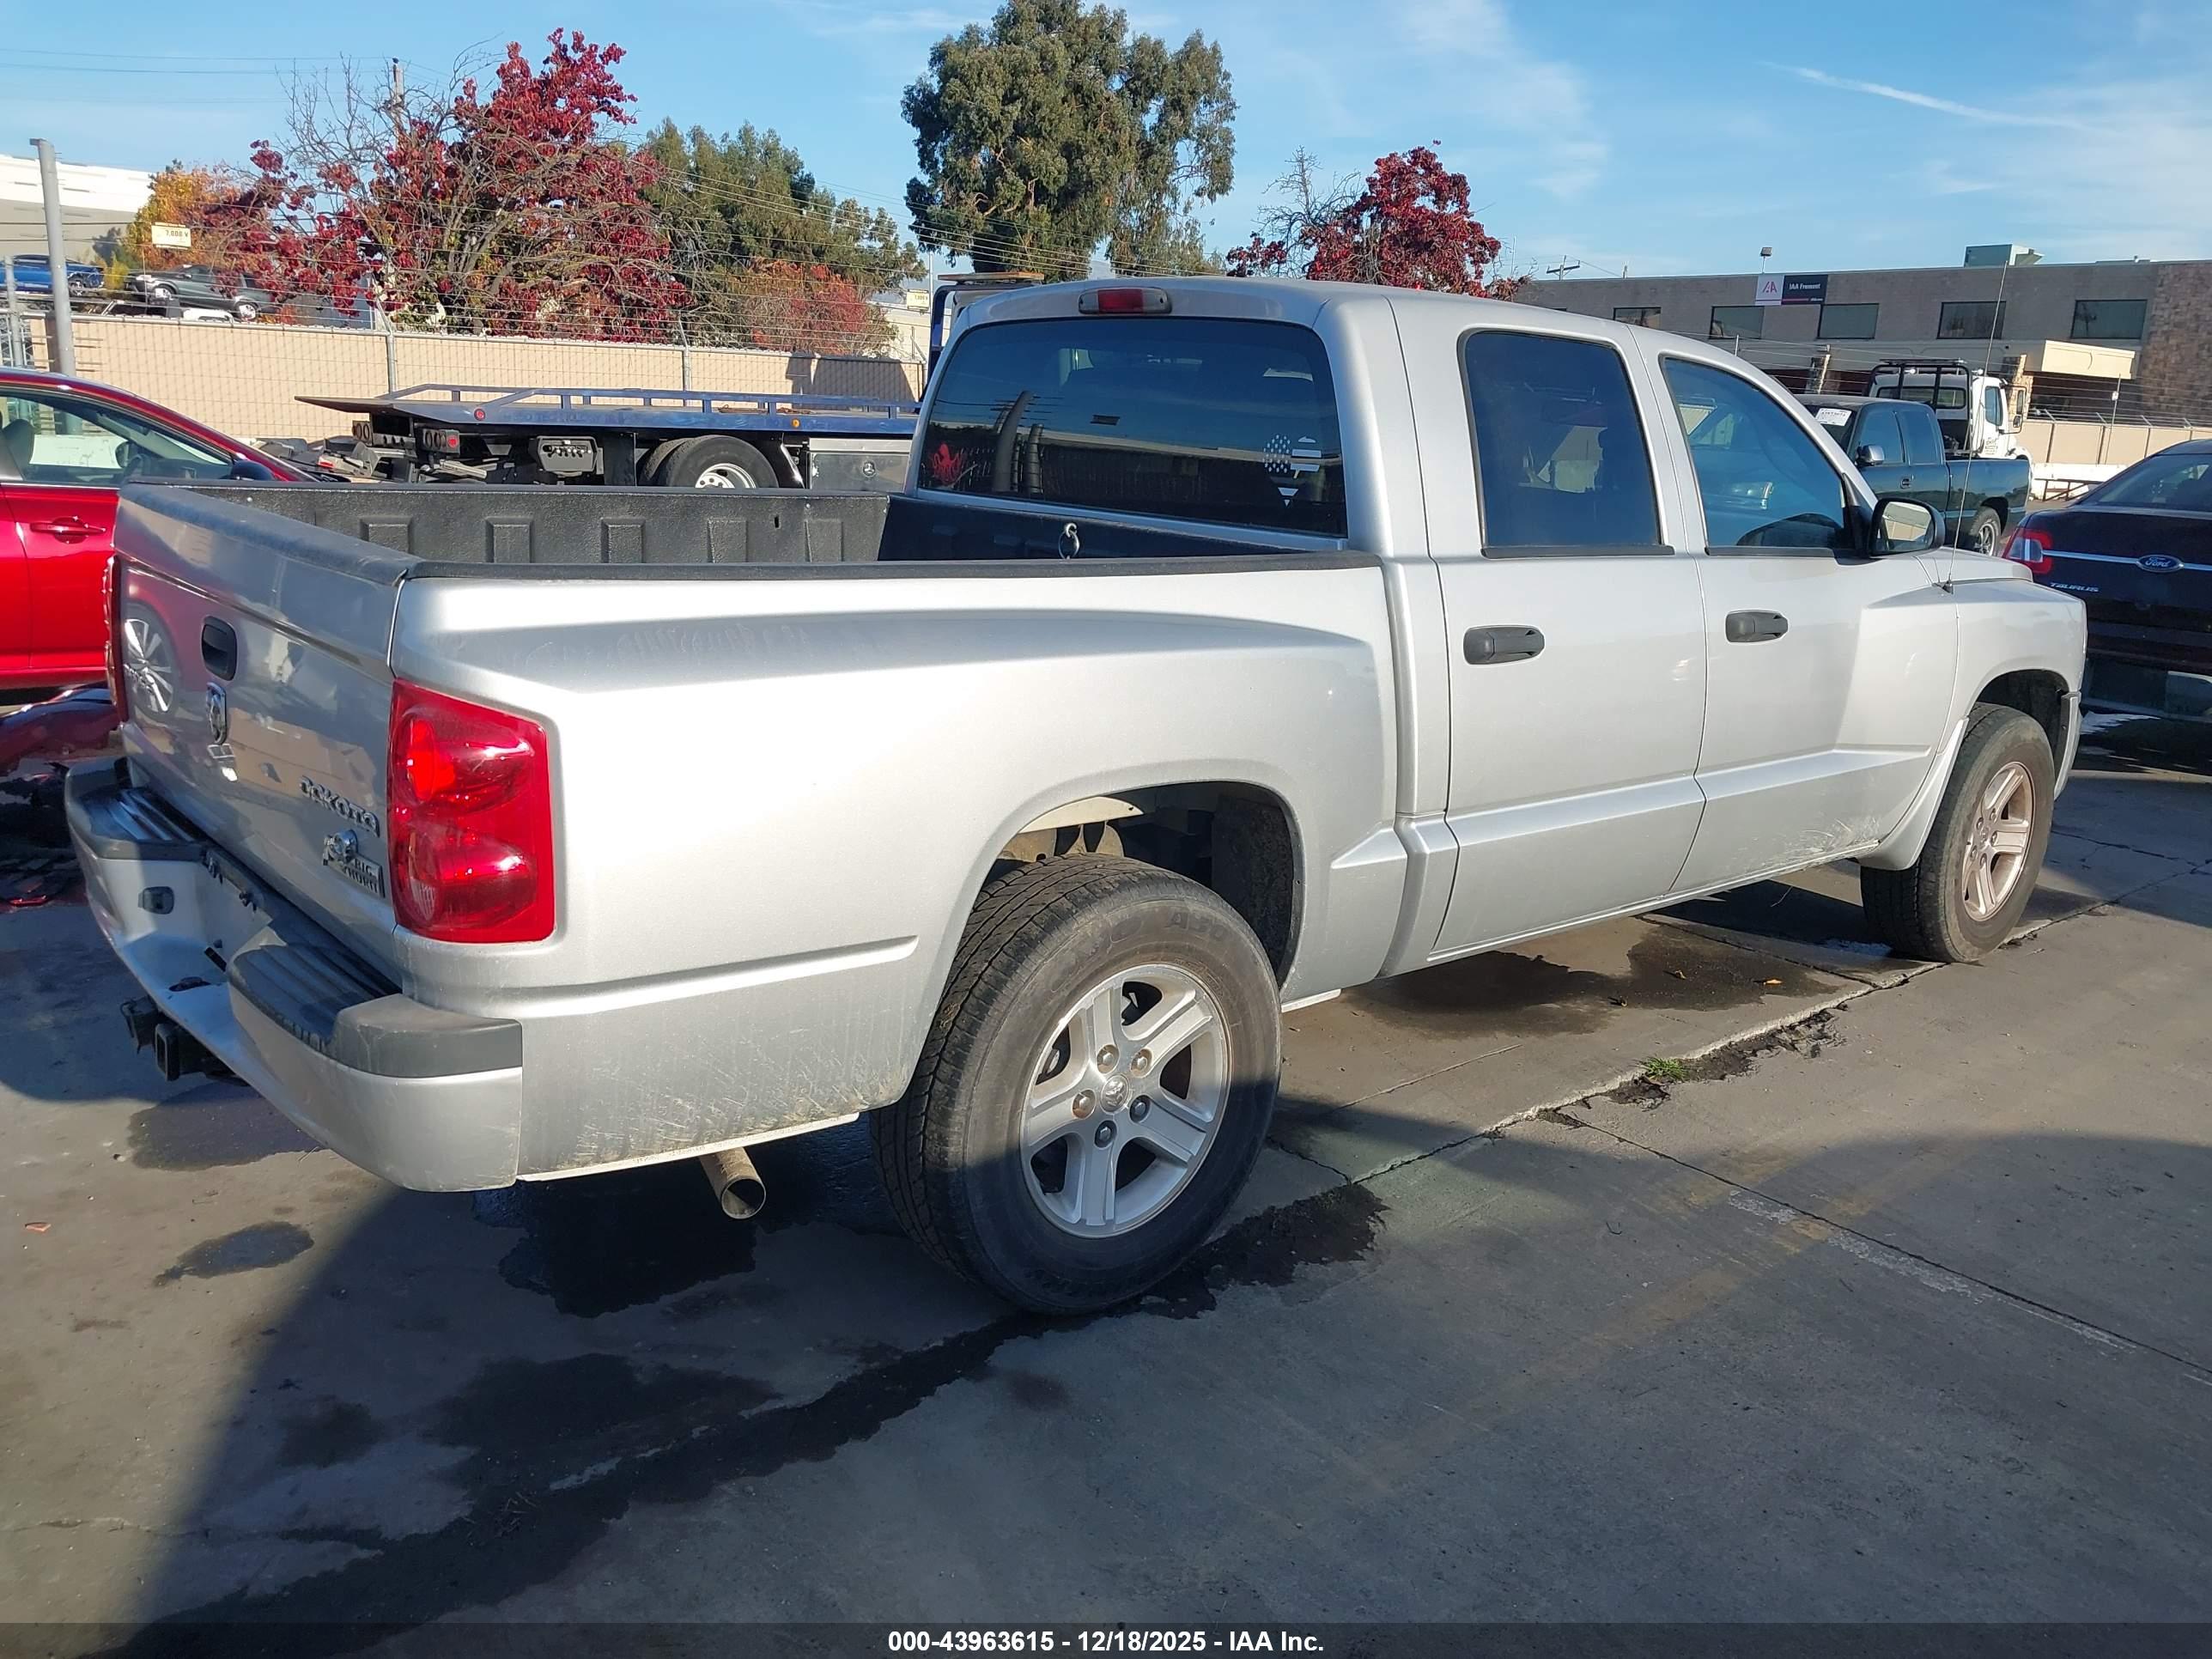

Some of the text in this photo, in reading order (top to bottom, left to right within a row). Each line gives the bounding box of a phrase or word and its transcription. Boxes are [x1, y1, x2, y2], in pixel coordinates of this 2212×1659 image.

[2144, 556, 2171, 568] Ford
[2050, 582, 2100, 592] TAURUS
[354, 859, 373, 875] BIG
[345, 866, 379, 892] HORN
